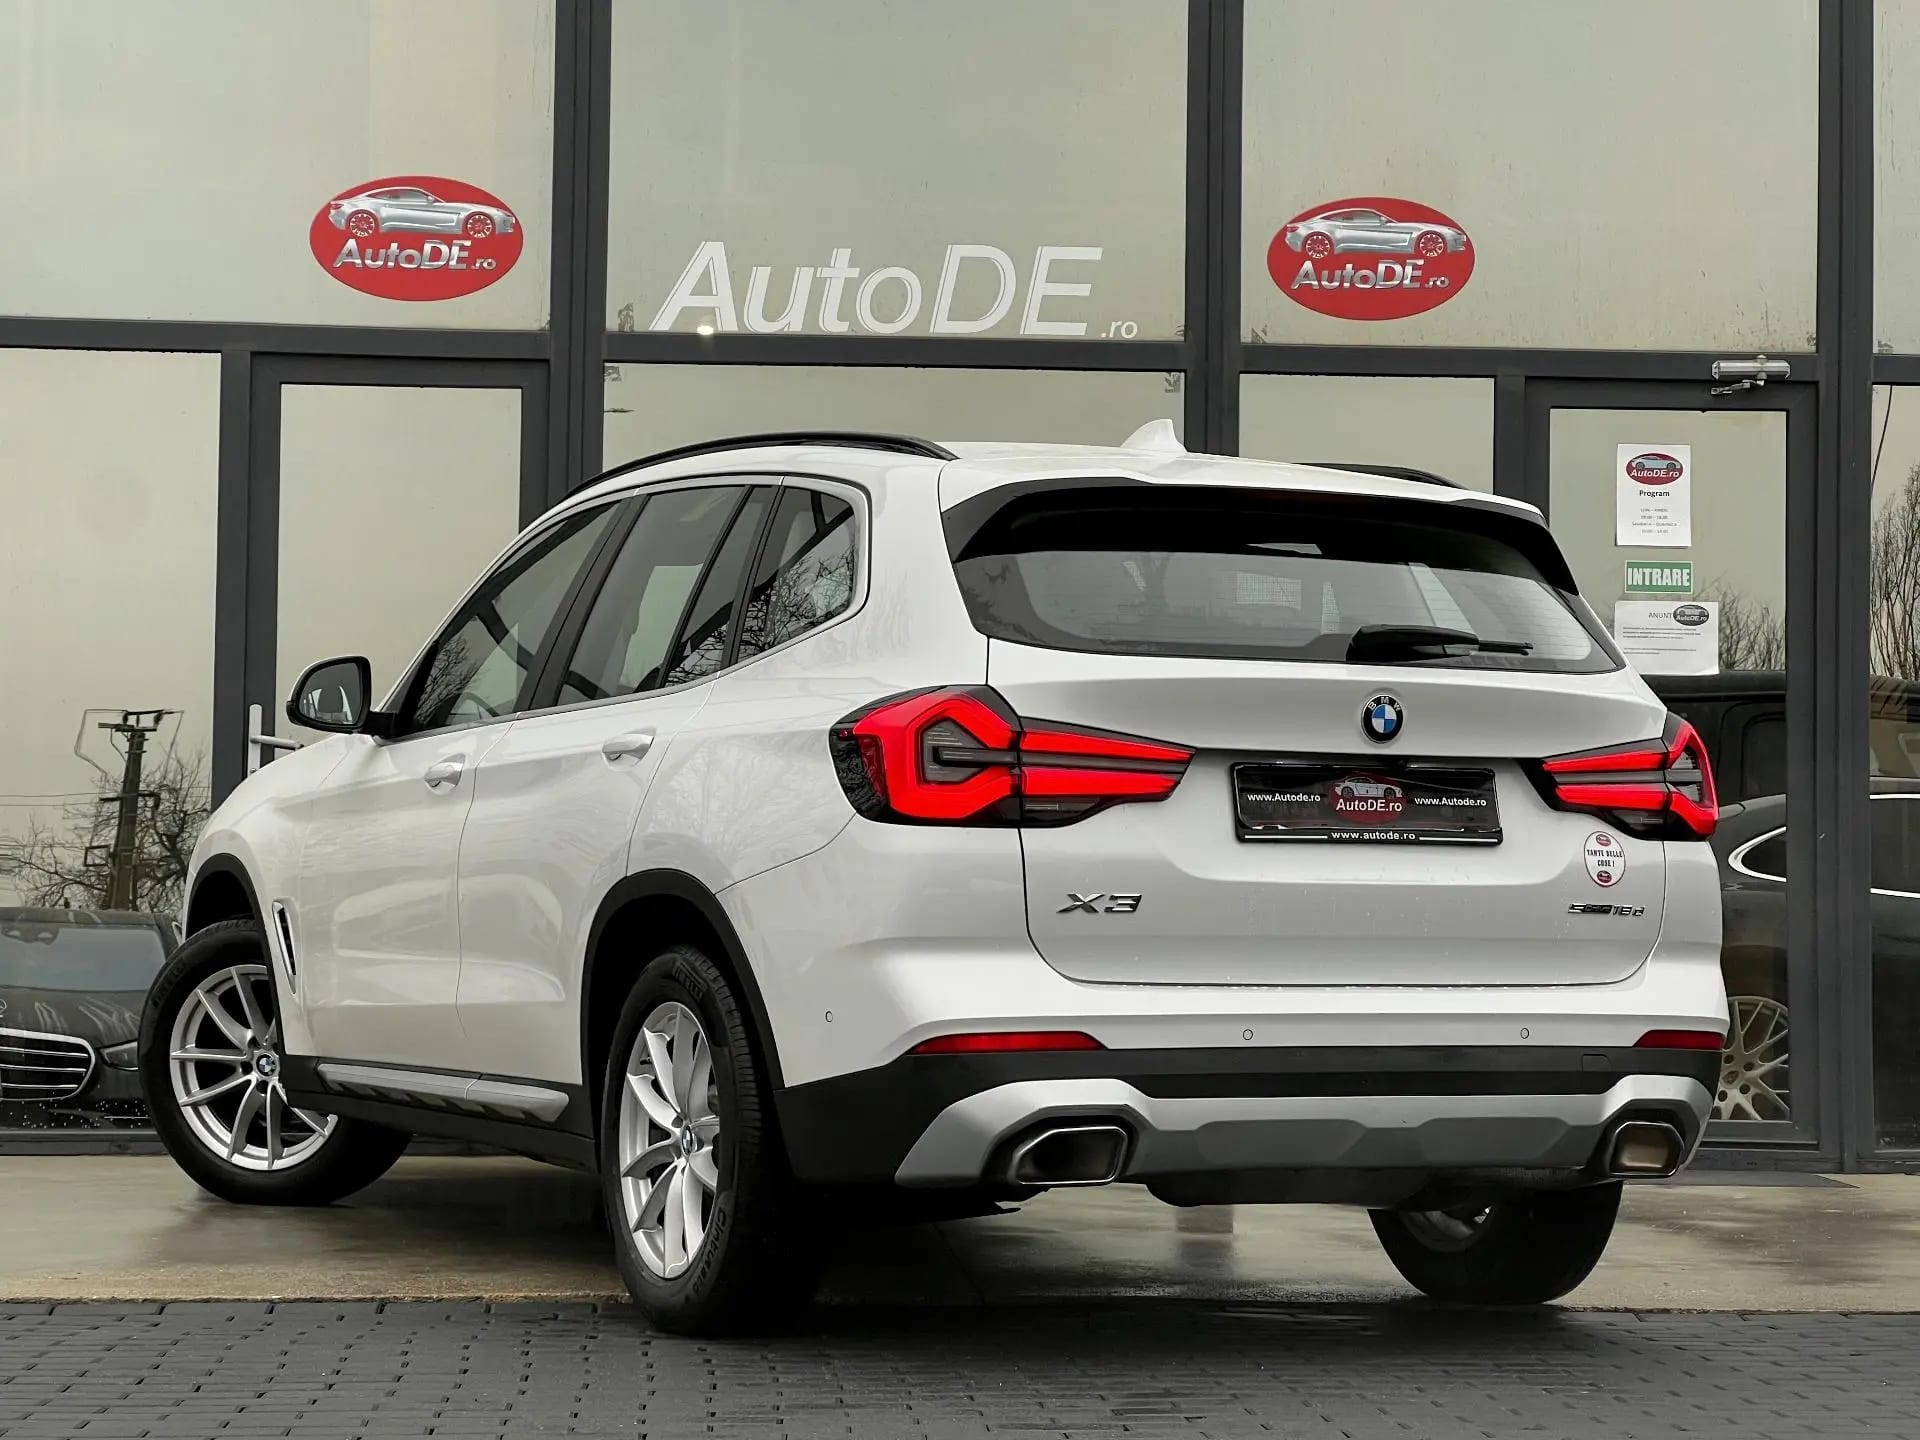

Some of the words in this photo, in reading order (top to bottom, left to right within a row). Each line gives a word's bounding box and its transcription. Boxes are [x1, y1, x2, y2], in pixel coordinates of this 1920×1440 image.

[1630, 469, 1680, 478] AutoDE.ro
[1639, 490, 1670, 498] Program
[1627, 567, 1690, 587] INTRARE
[1247, 792, 1321, 803] www.Autode.ro
[1414, 796, 1487, 807] www.Autode.ro
[1335, 798, 1403, 813] AutoDE.ro
[1331, 830, 1416, 841] www.autode.ro
[1597, 859, 1612, 867] COSE
[1056, 892, 1143, 914] X3
